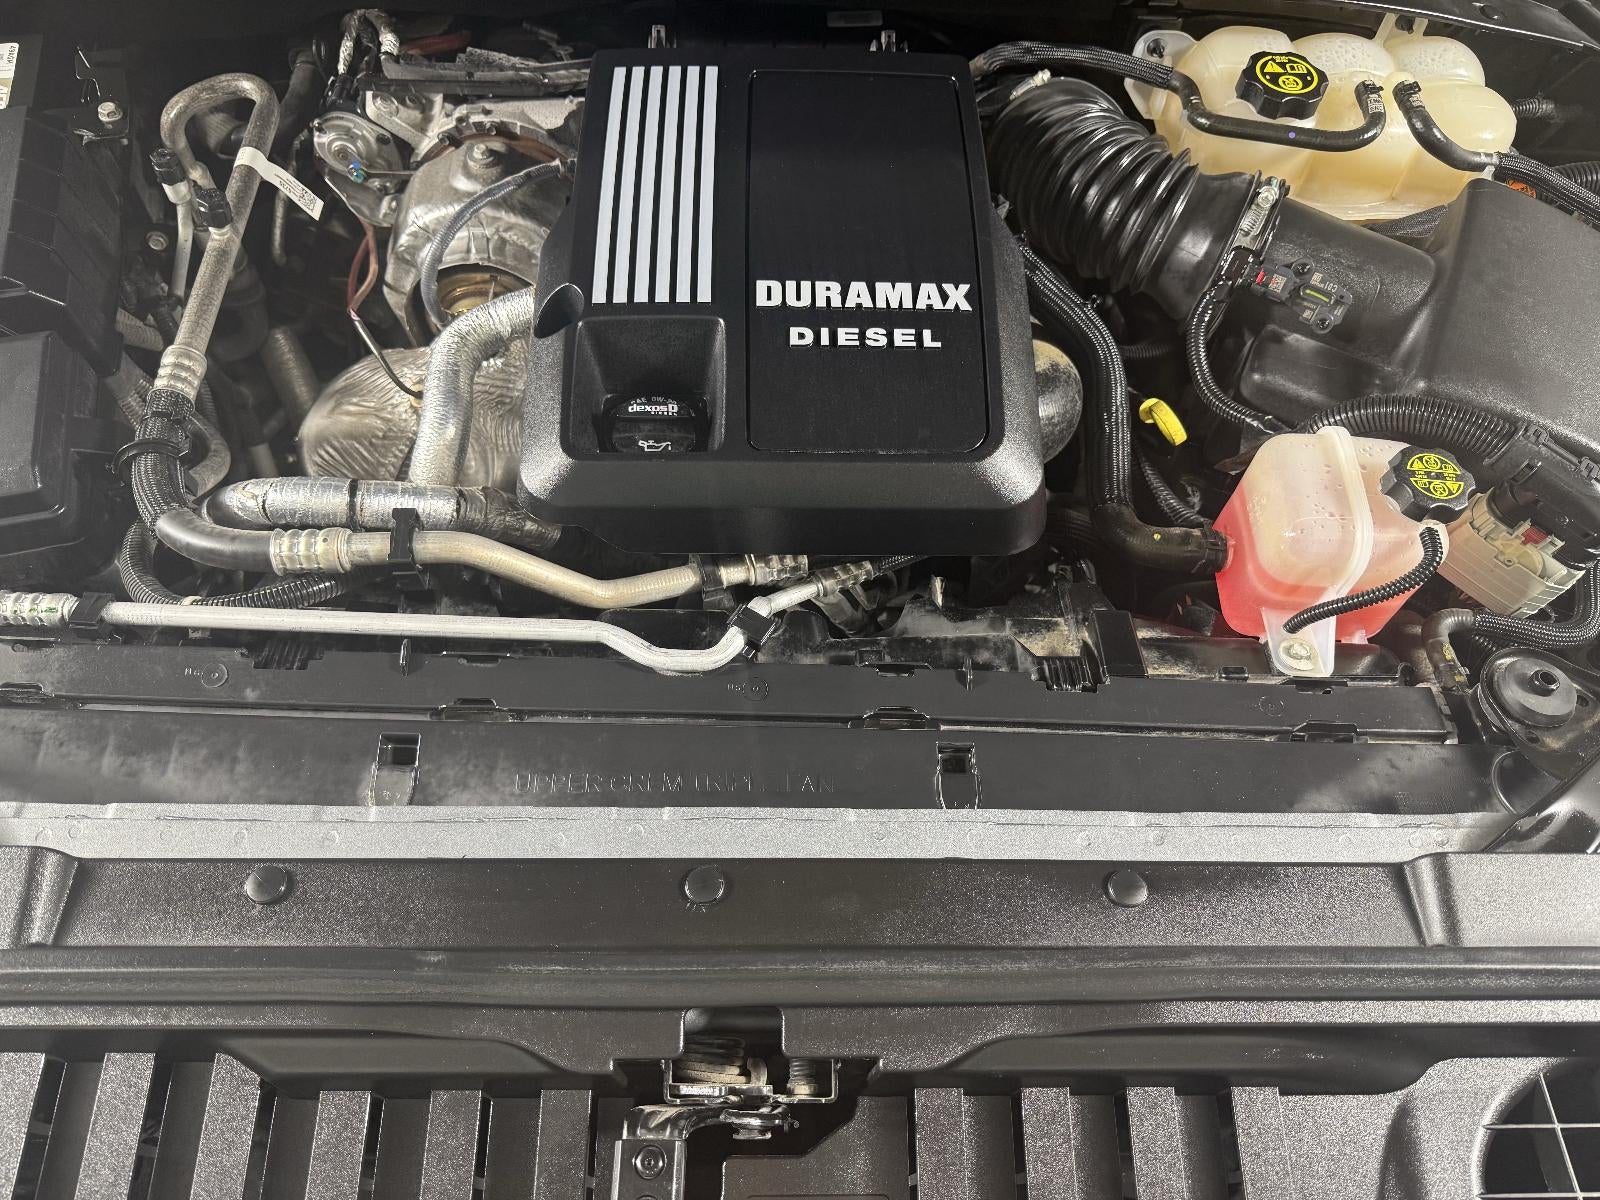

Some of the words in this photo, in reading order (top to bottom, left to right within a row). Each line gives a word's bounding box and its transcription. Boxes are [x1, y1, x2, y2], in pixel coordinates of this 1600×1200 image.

[755, 279, 973, 312] DURAMAX
[789, 326, 942, 348] DIESEL
[514, 773, 602, 793] UPPER
